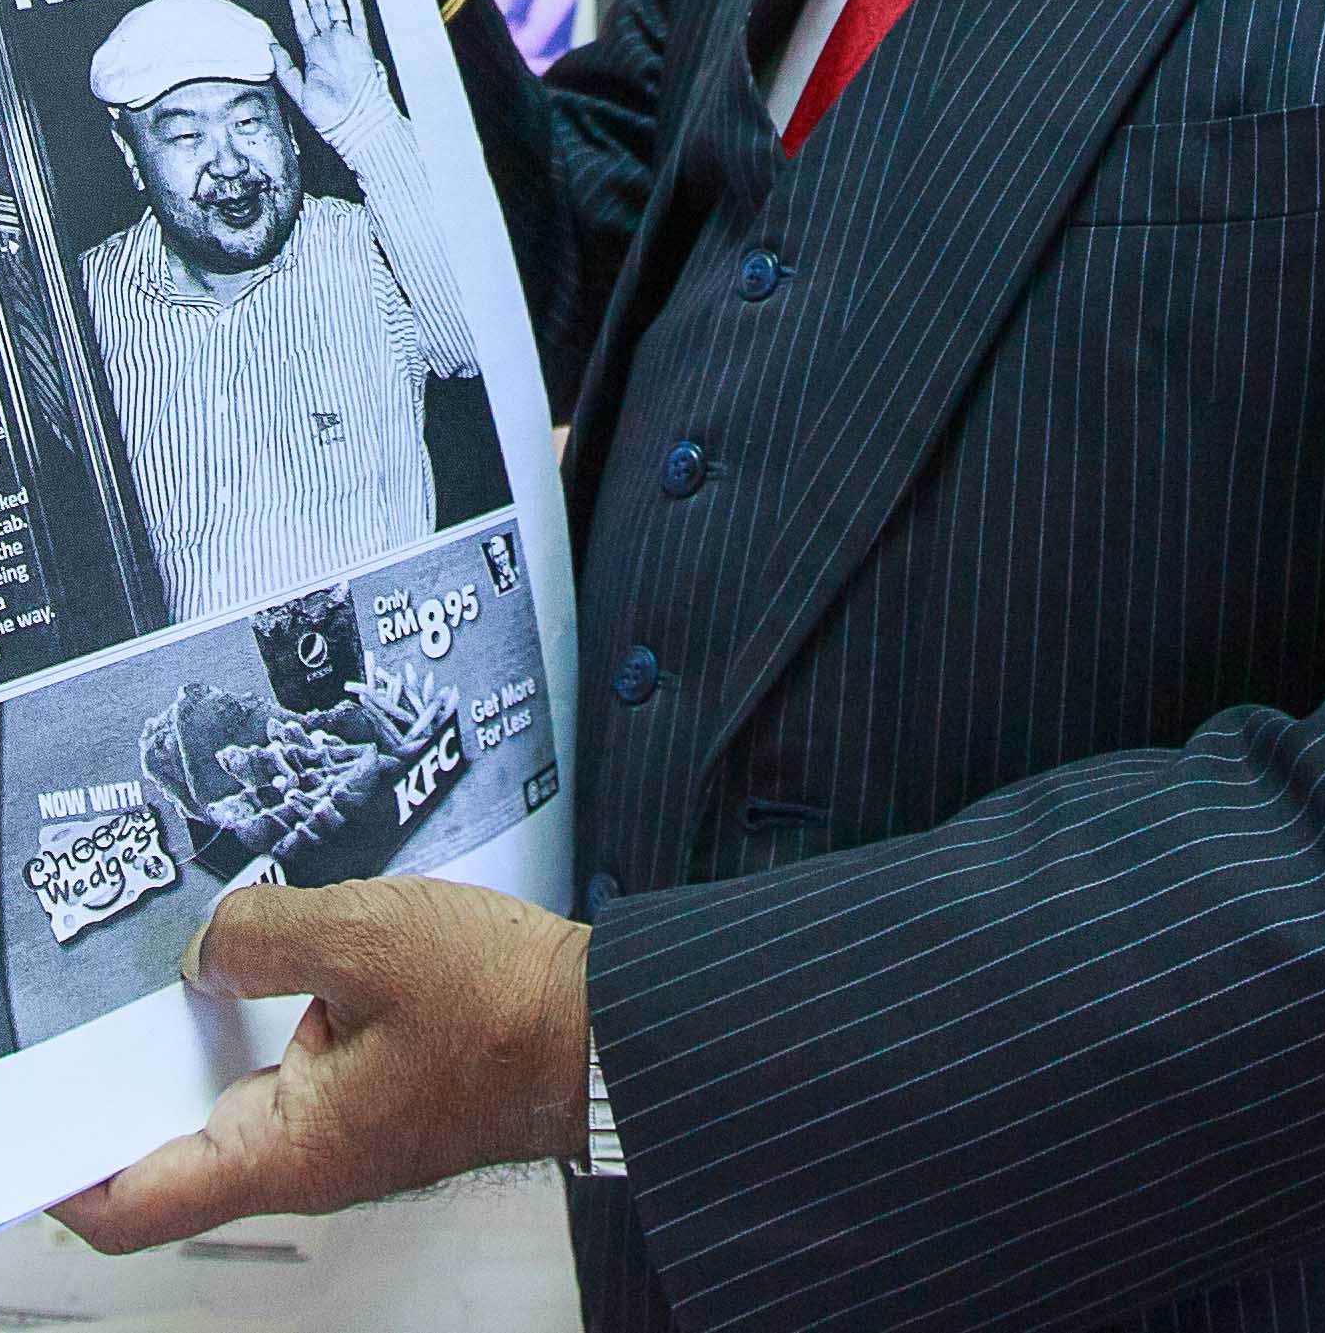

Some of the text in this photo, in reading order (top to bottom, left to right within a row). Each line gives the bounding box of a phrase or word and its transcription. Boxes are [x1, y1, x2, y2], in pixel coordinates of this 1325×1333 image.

[16, 605, 55, 627] way.
[374, 588, 410, 616] Only
[471, 675, 537, 723] Get More
[475, 708, 532, 751] For Less
[394, 727, 460, 826] KFC
[38, 780, 144, 819] NOW WITH
[45, 825, 158, 910] Wedges
